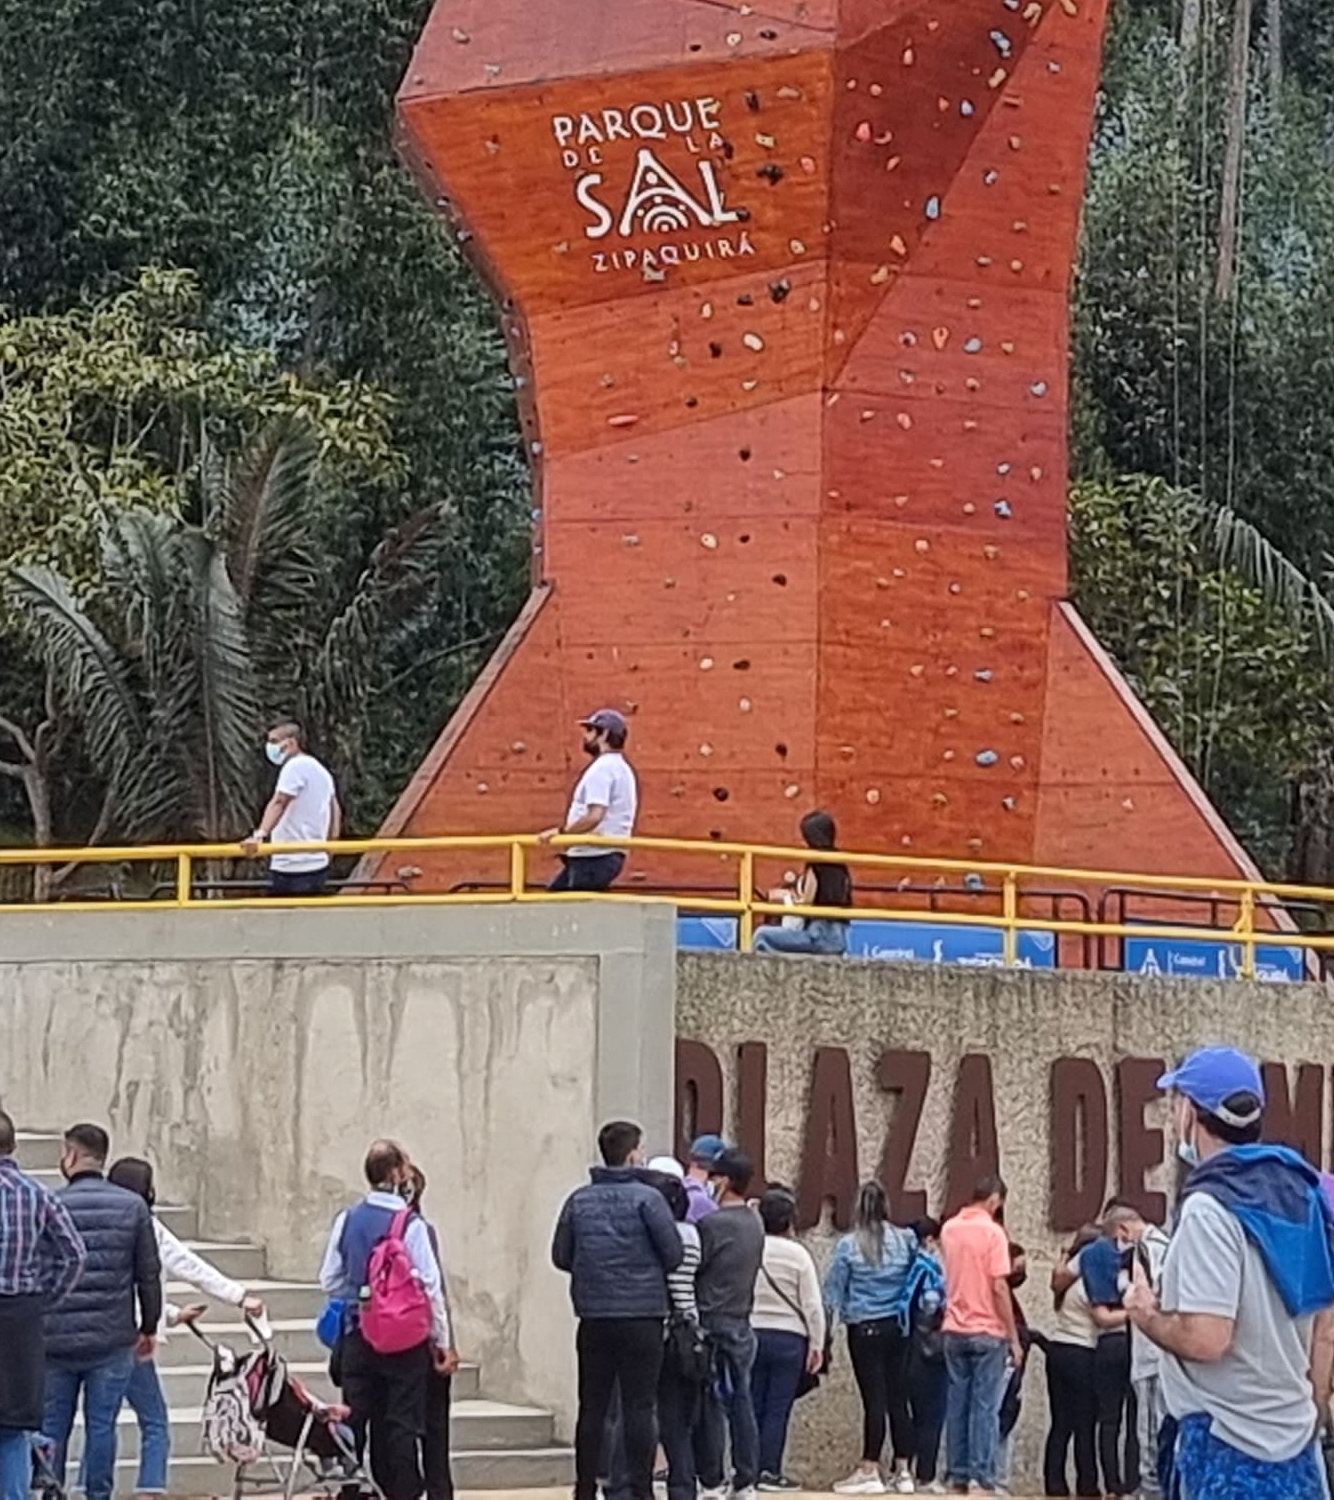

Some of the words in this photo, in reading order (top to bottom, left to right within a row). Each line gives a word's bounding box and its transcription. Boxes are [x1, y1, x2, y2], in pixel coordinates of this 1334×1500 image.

[552, 97, 721, 147] PARQUE
[563, 146, 603, 168] DE
[686, 132, 725, 154] LA
[576, 149, 740, 238] SAL
[591, 232, 756, 273] ZIPAQUIRÁ
